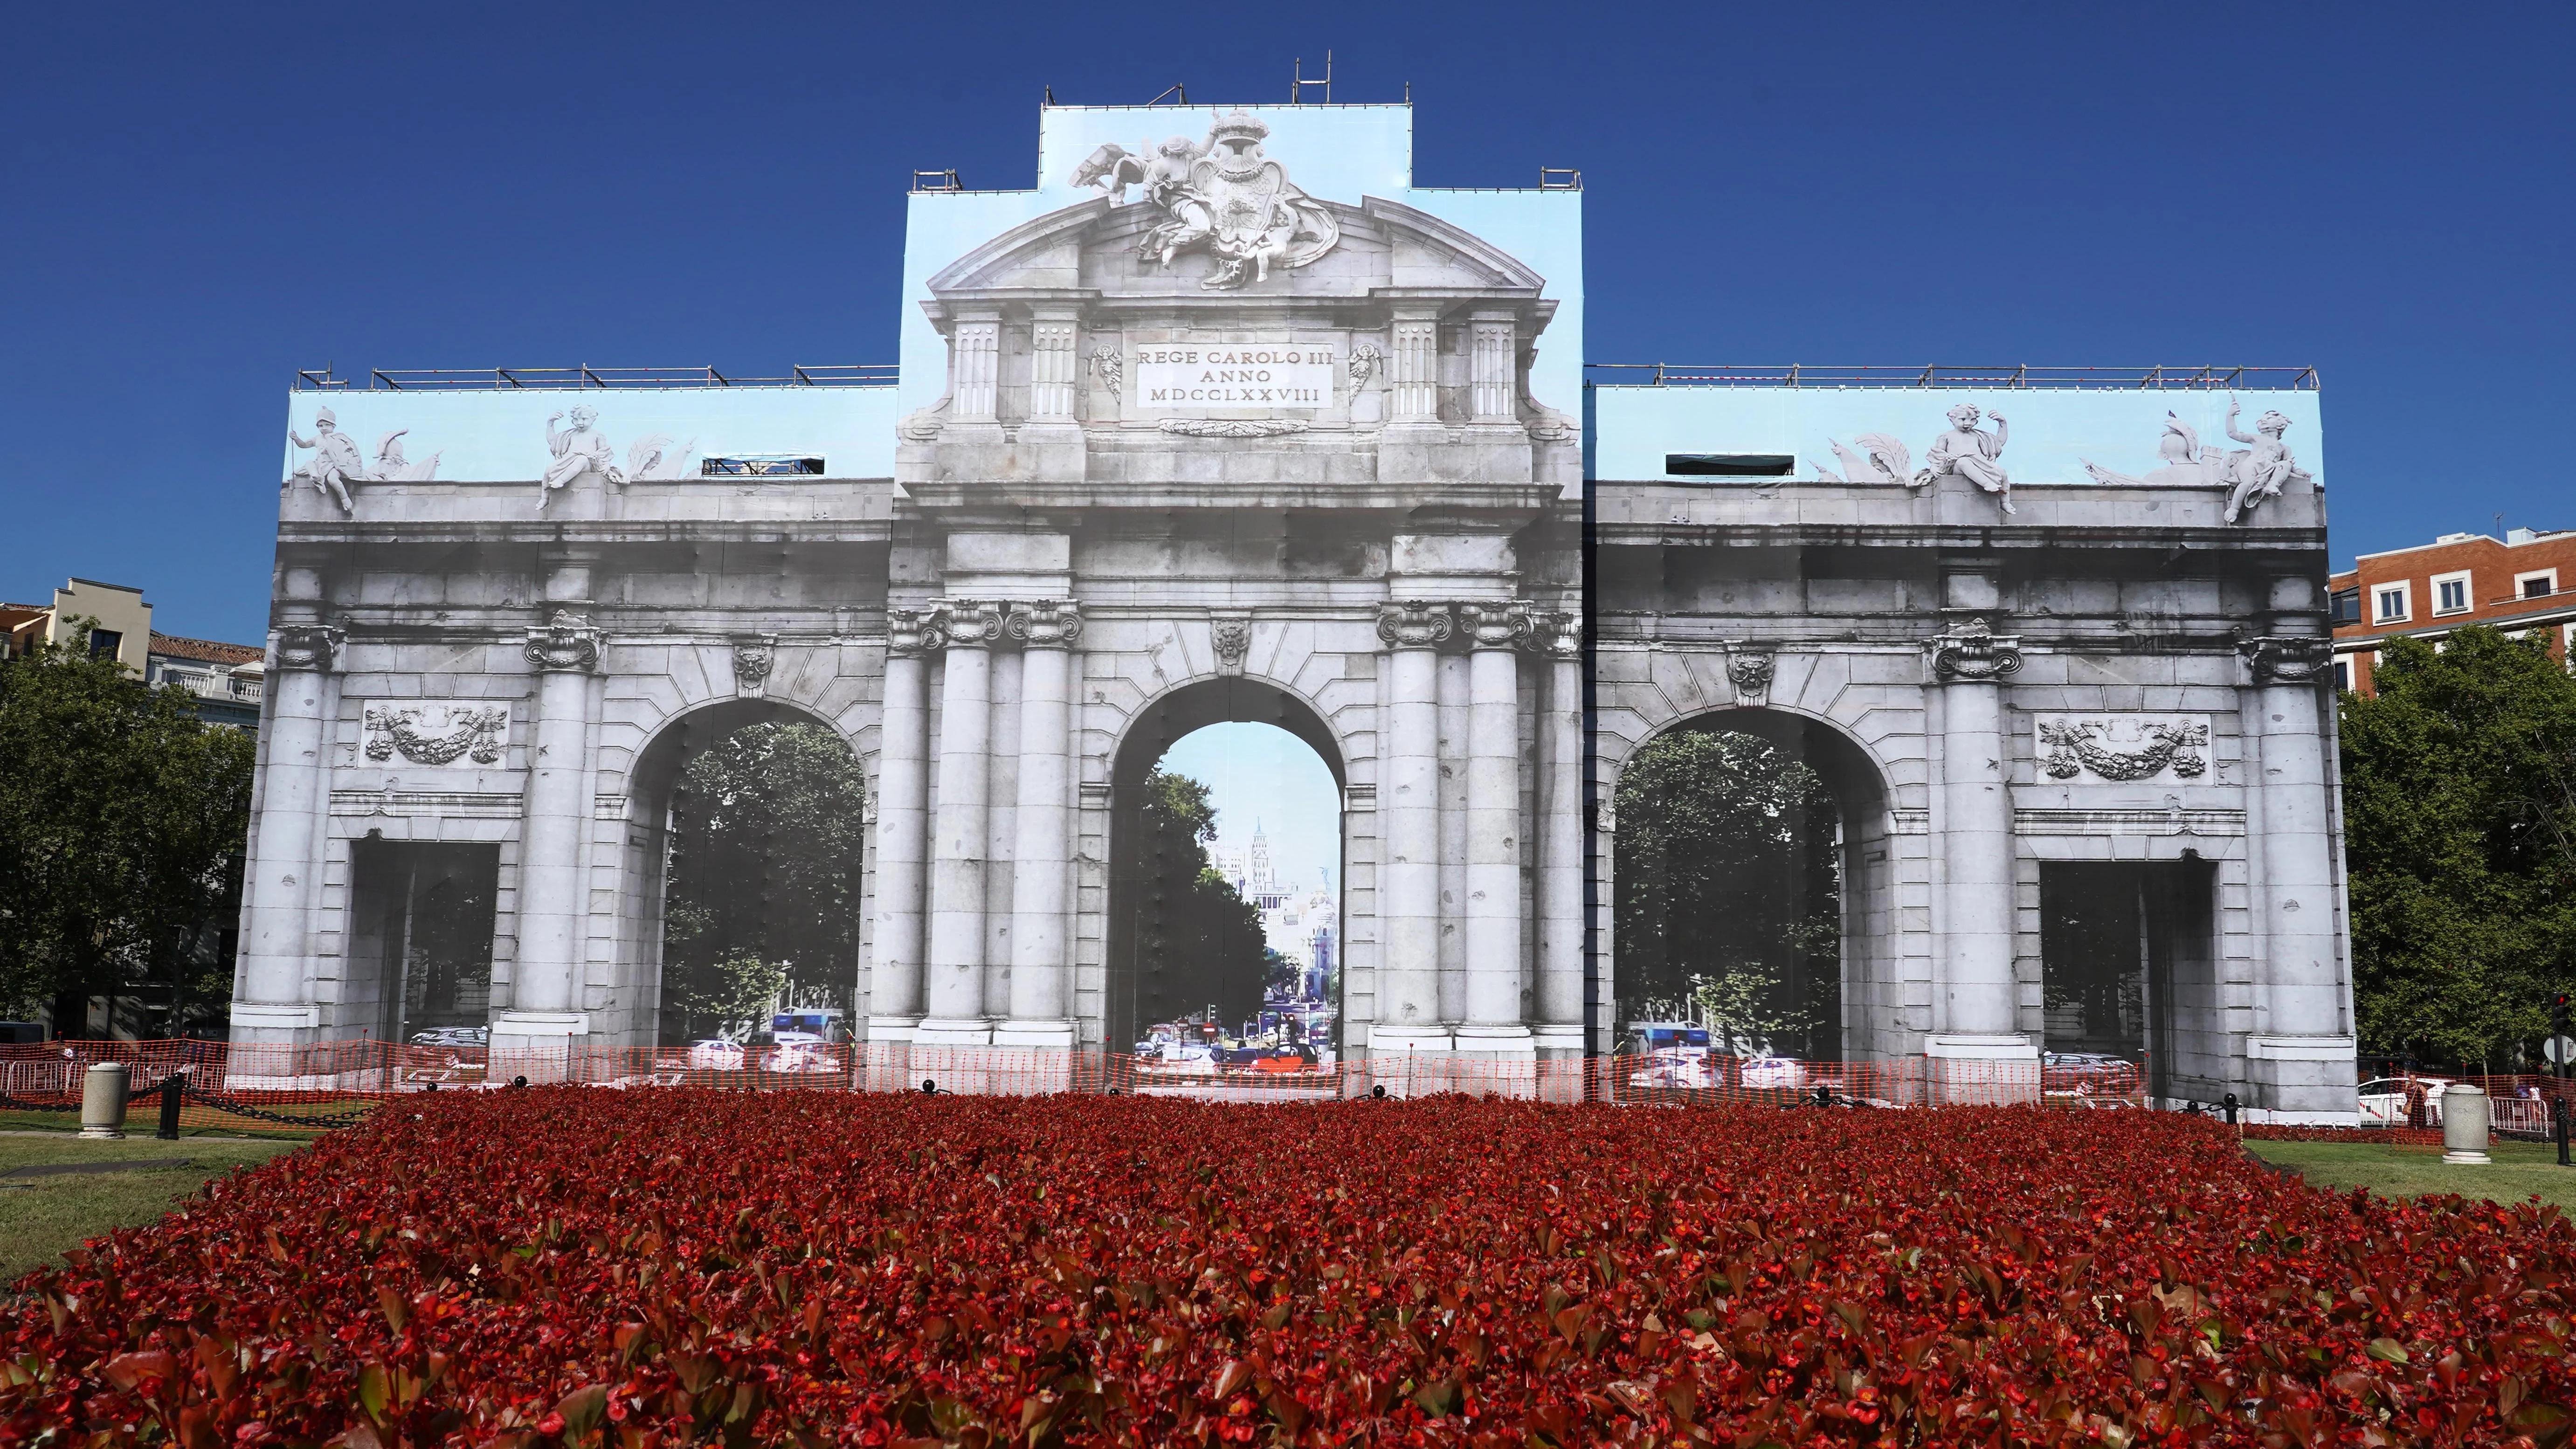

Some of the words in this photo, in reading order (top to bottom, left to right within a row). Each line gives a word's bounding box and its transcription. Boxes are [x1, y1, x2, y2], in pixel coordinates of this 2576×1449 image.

[1138, 352, 1198, 364] REGE
[1207, 352, 1300, 364] CAROLO
[1308, 352, 1333, 364] III
[1200, 370, 1271, 382] ANNO
[1150, 388, 1319, 400] MDCCLXXVIII
